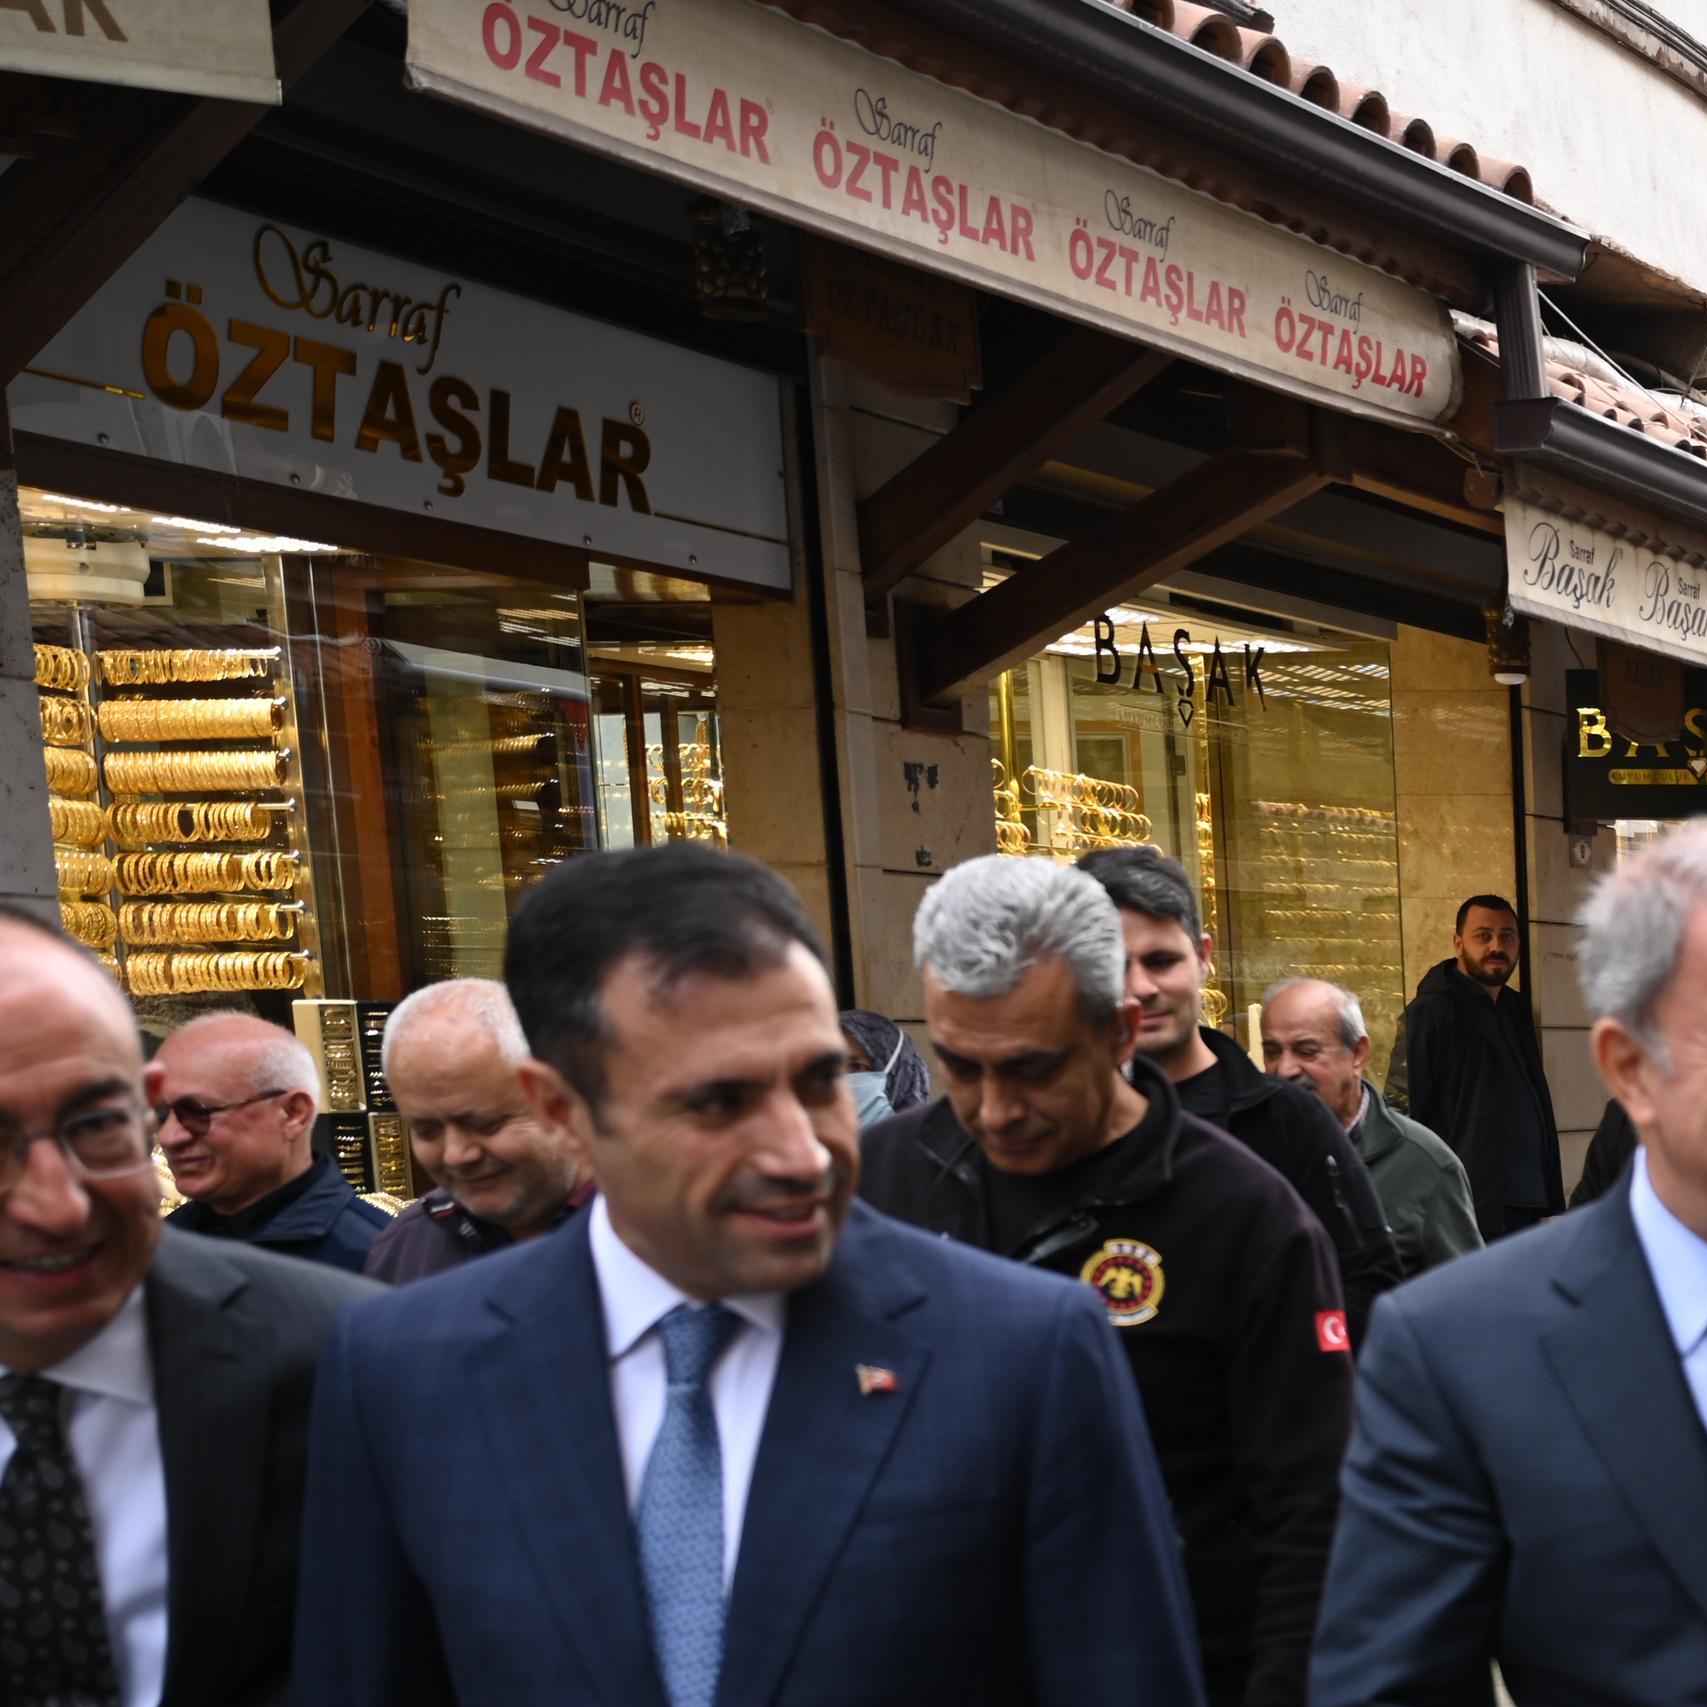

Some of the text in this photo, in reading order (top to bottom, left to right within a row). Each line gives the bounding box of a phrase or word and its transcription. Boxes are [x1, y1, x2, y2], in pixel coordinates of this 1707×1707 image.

[482, 0, 771, 165] ÖZTAŞLAR
[853, 88, 943, 173] Sarraf
[812, 117, 1036, 262] ÖZTAŞLAR
[1104, 188, 1175, 261] Sarraf
[253, 224, 461, 376] Sarraf
[1068, 217, 1247, 338] ÖZTAŞLAR
[1304, 269, 1364, 334] Sarraf
[1274, 297, 1427, 398] ÖZTAŞLAR
[143, 278, 653, 516] ÖZTAŞLAR
[1523, 521, 1618, 609] Başak
[1569, 539, 1595, 566] Sarraf
[1678, 577, 1701, 600] Sarraf
[1094, 615, 1268, 712] BAŞAK
